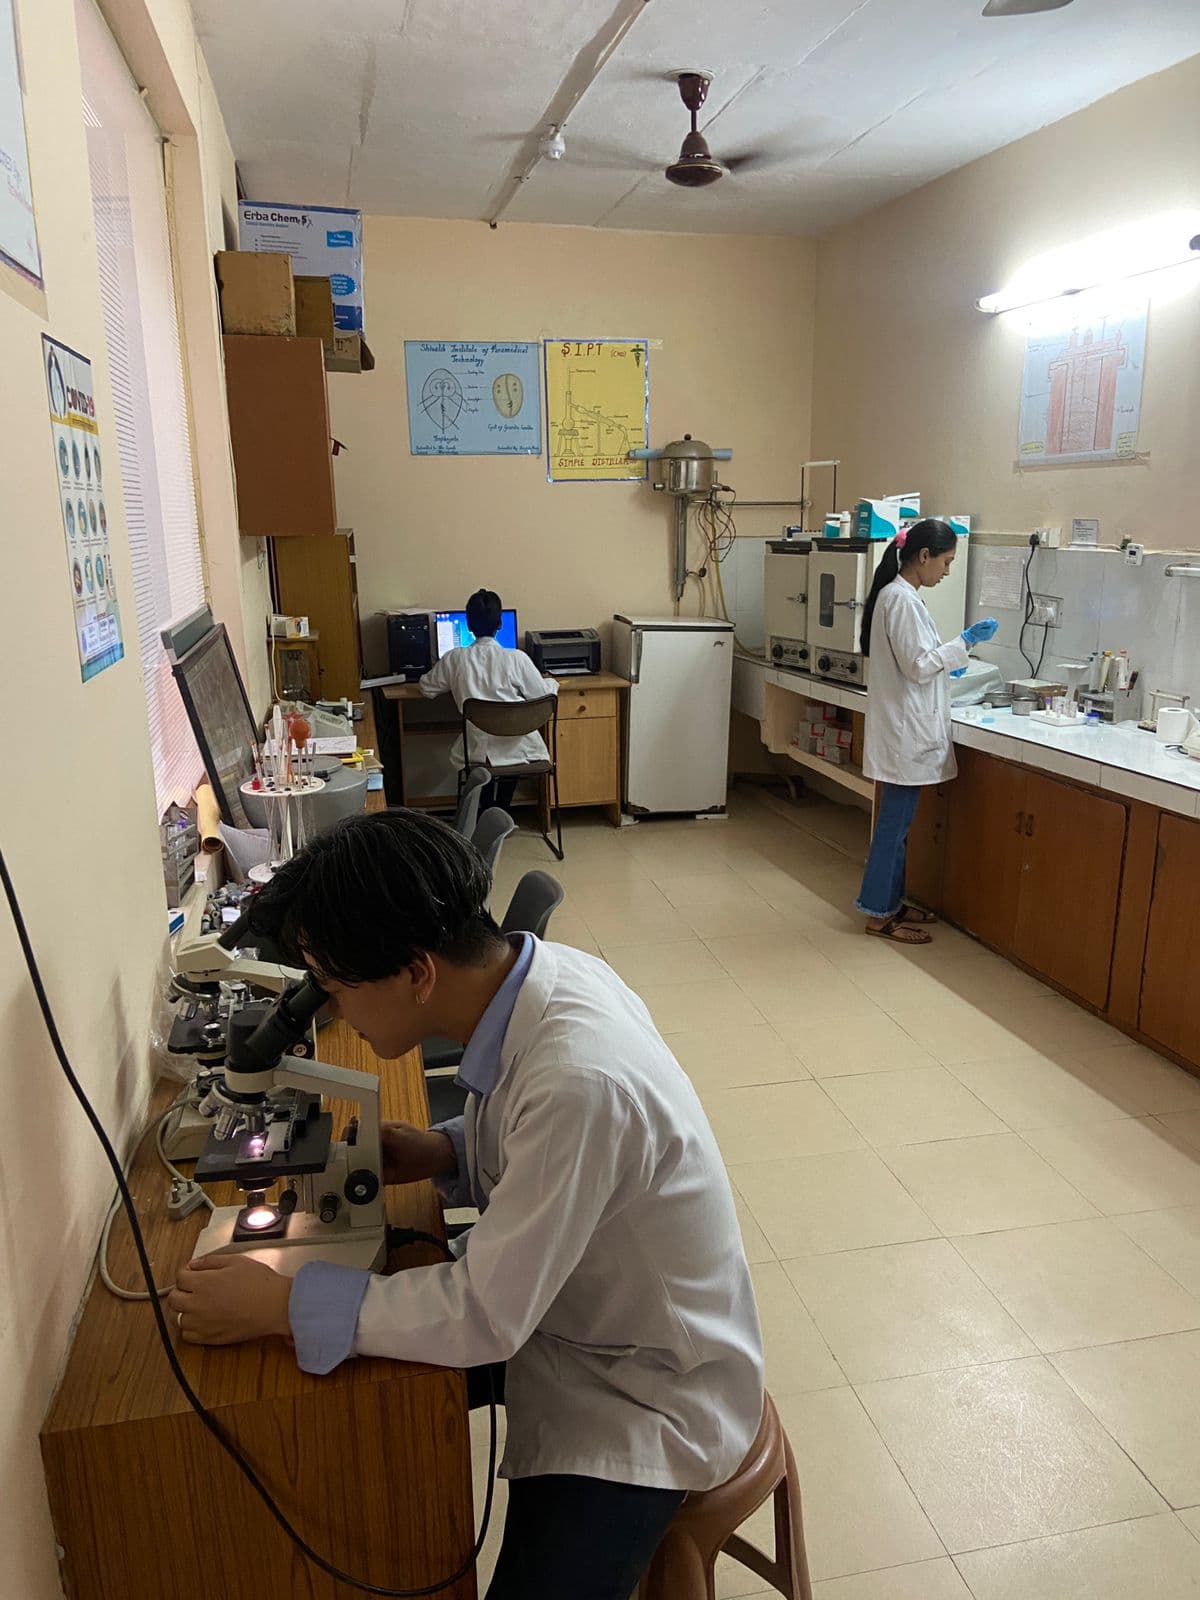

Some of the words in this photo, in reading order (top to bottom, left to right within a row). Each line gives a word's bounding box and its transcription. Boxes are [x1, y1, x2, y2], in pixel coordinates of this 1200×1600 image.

[244, 210, 269, 220] Erba
[450, 354, 484, 367] Technology
[558, 458, 585, 468] SIMPLE
